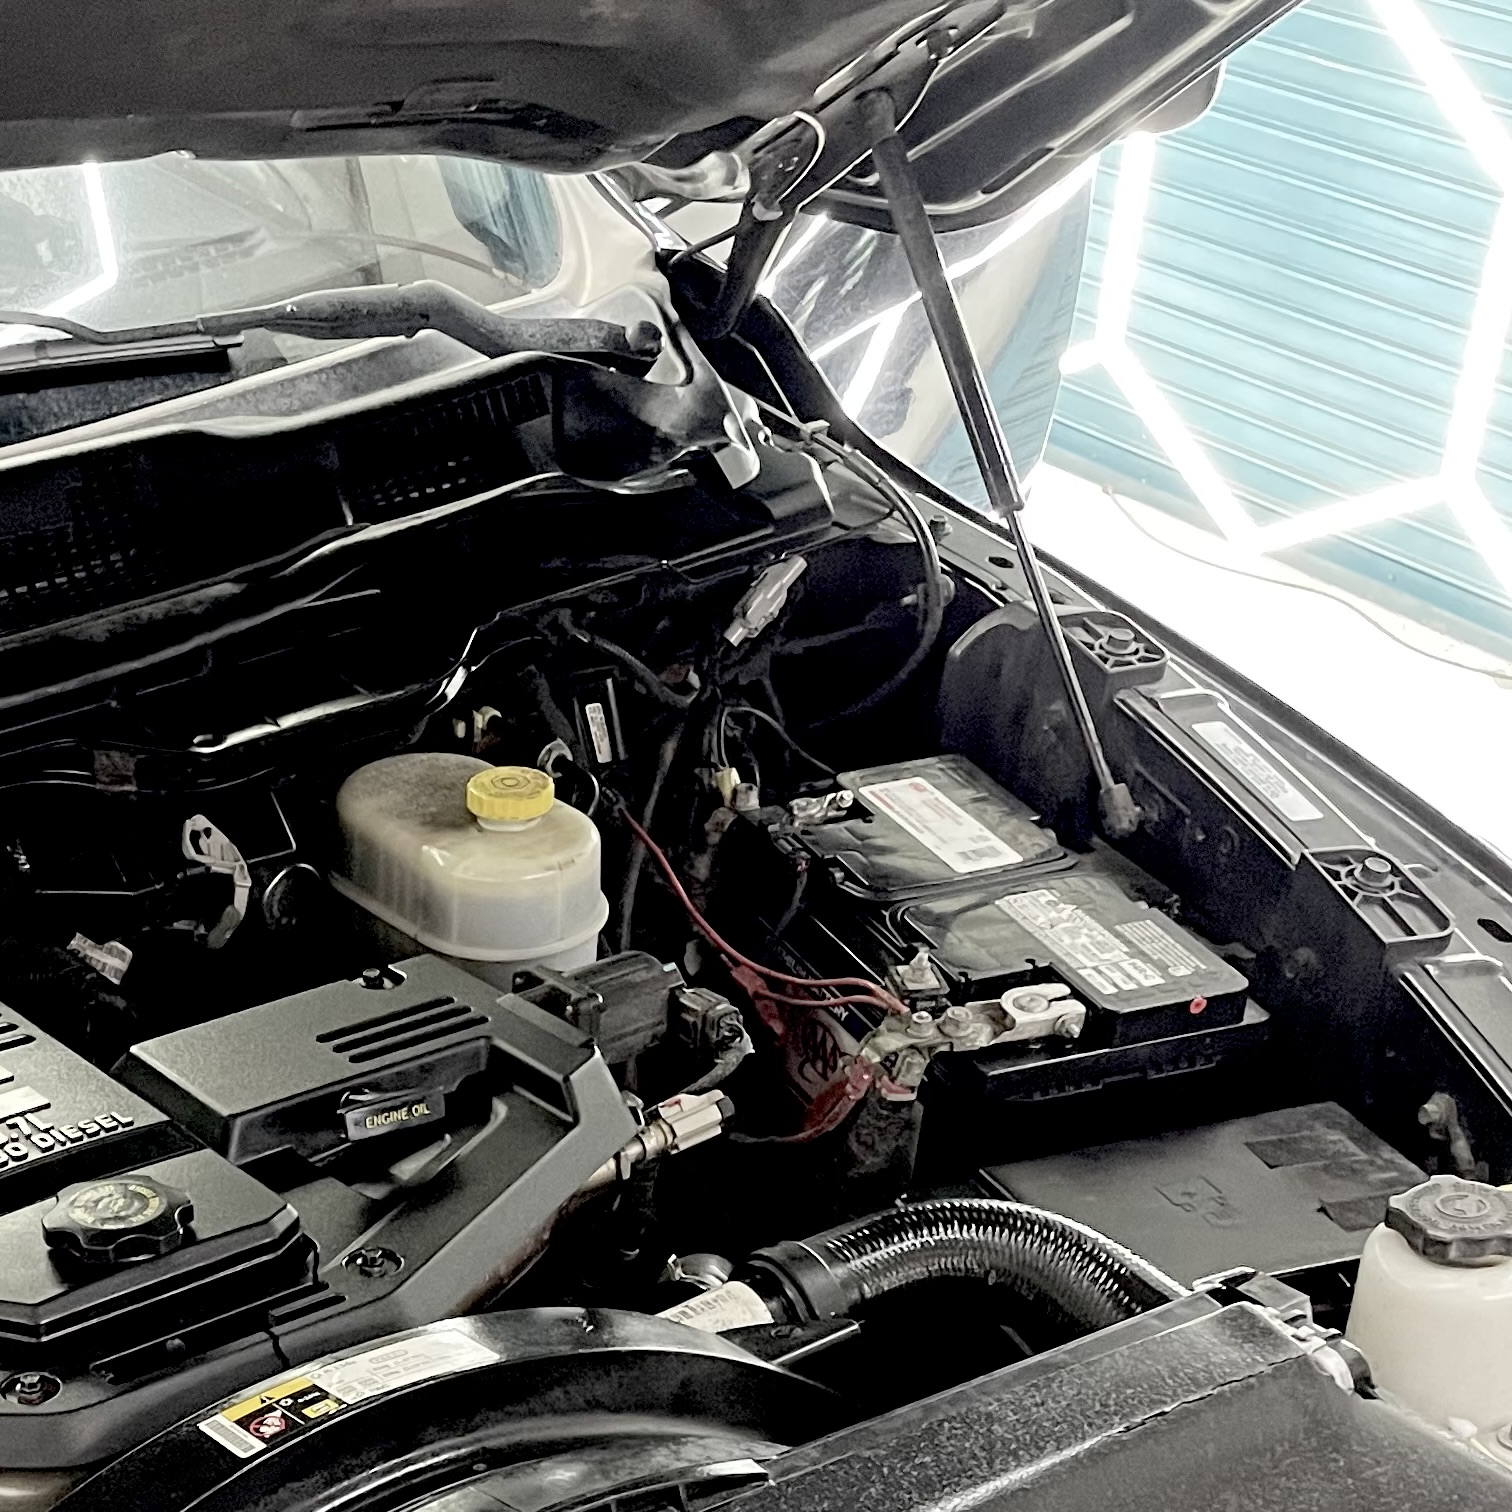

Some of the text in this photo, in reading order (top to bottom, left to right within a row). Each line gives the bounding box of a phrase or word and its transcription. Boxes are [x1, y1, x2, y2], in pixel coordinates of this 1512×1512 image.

[31, 1111, 135, 1153] DIESEL
[366, 1103, 430, 1129] ENGINE OIL
